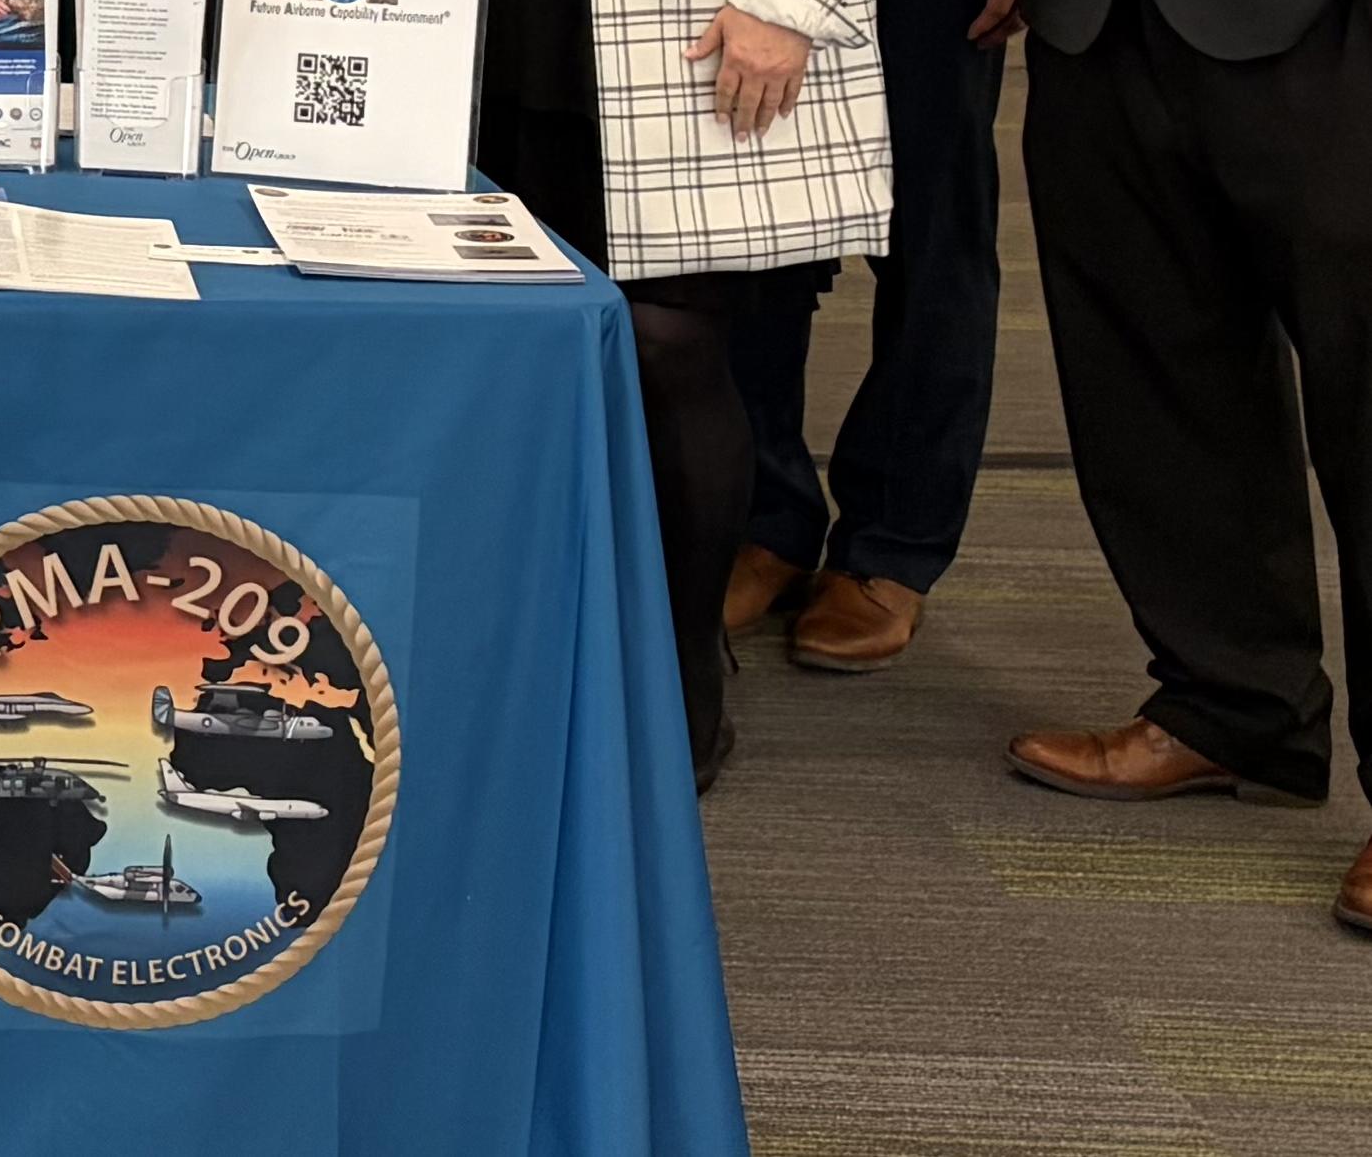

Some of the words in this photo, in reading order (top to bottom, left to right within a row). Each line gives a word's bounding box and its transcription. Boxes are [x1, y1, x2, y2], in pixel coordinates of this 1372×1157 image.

[250, 0, 280, 15] Future
[284, 2, 326, 18] Airborne
[330, 5, 379, 23] Capability
[235, 141, 275, 162] Open
[112, 890, 311, 987] ELECTRONICS
